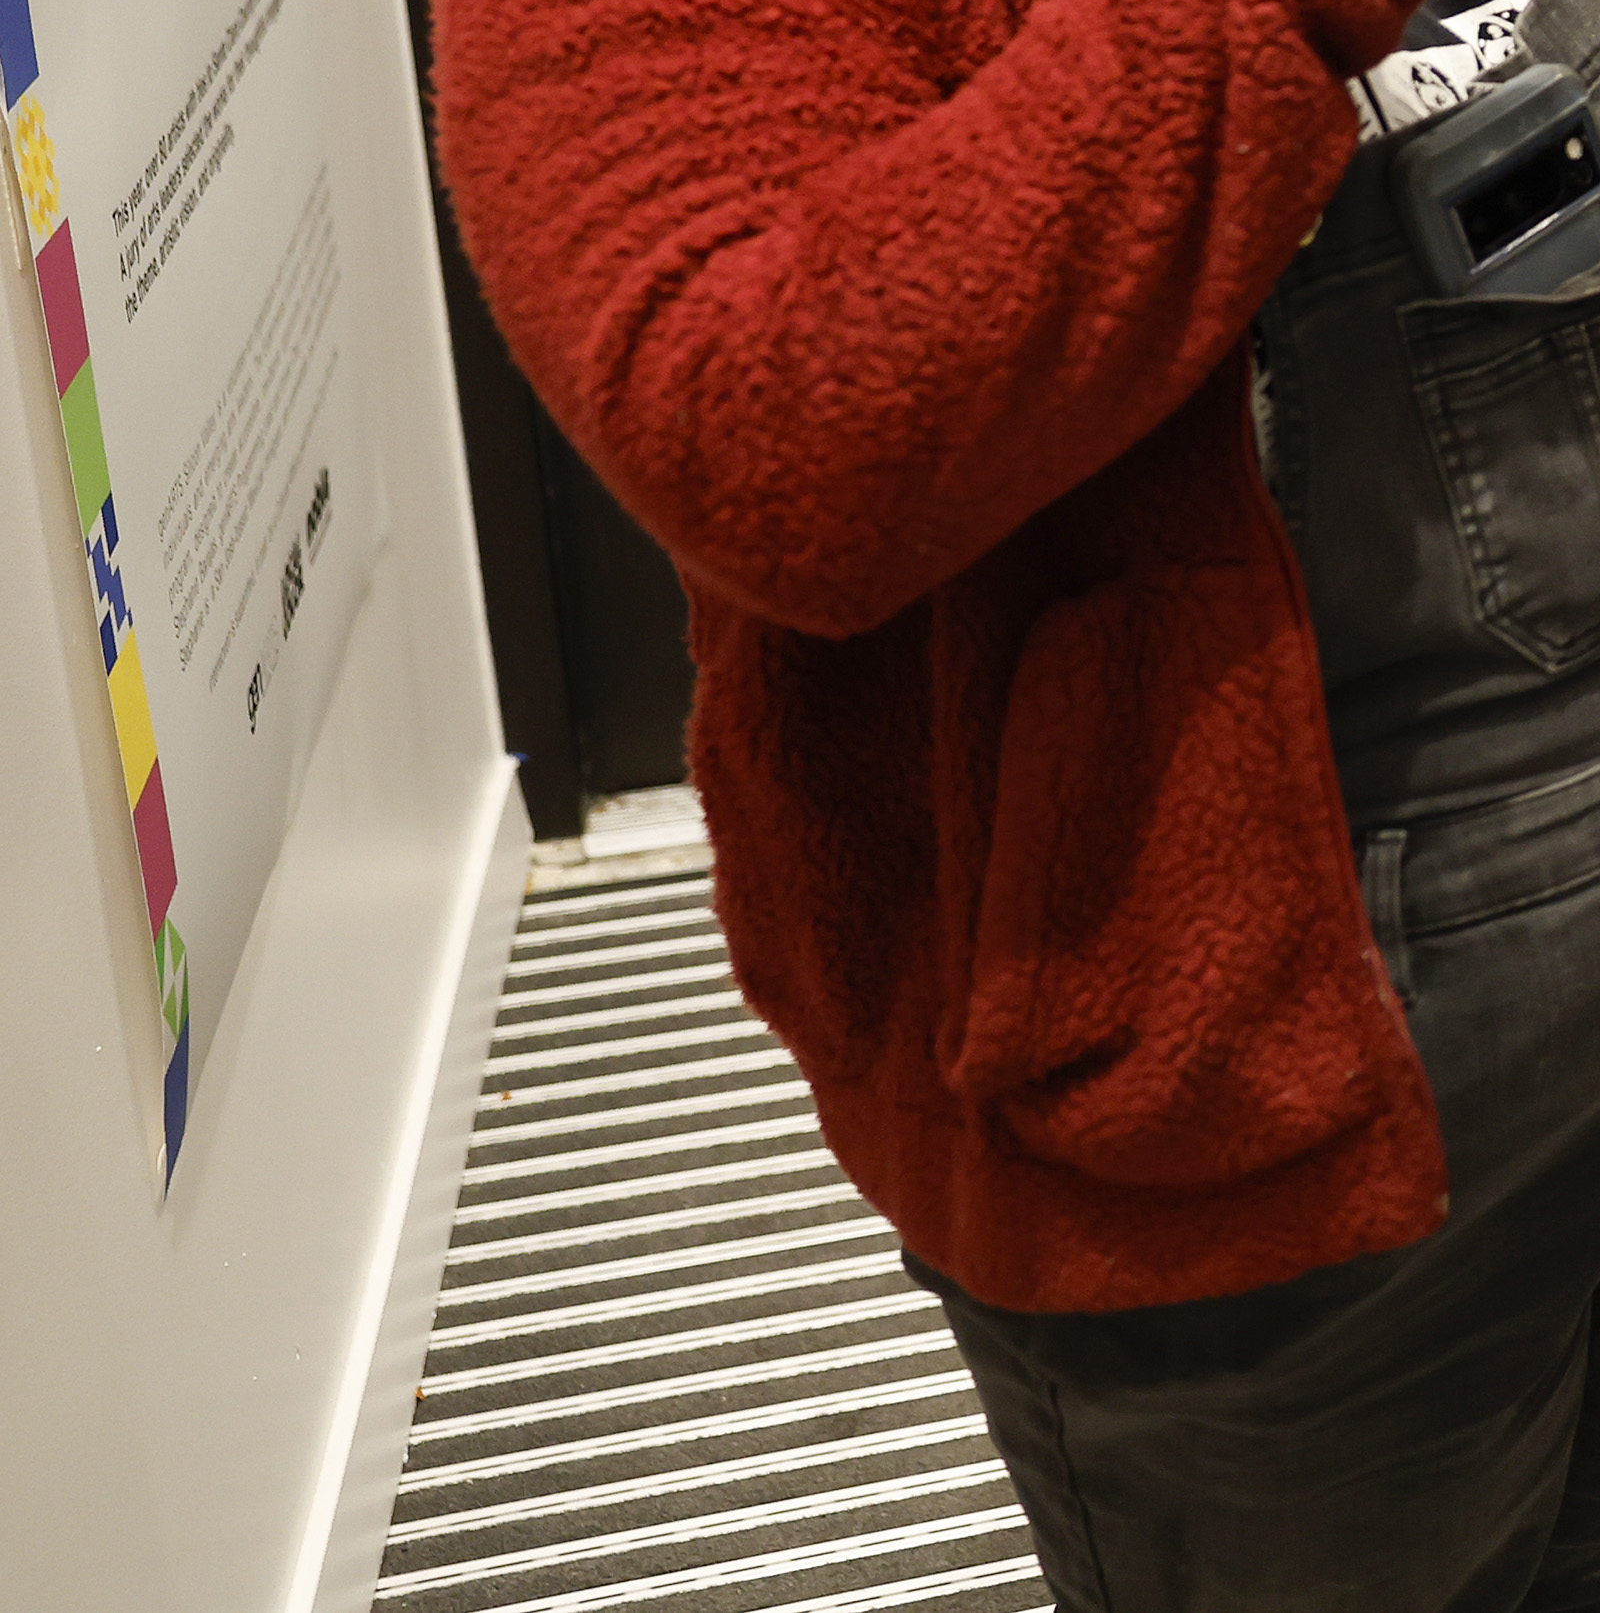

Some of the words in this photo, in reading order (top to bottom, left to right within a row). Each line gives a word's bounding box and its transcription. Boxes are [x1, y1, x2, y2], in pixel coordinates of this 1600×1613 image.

[111, 200, 129, 237] This
[166, 109, 186, 153] artists
[124, 234, 140, 279] jury
[158, 164, 182, 214] leaders
[158, 217, 180, 267] artistic
